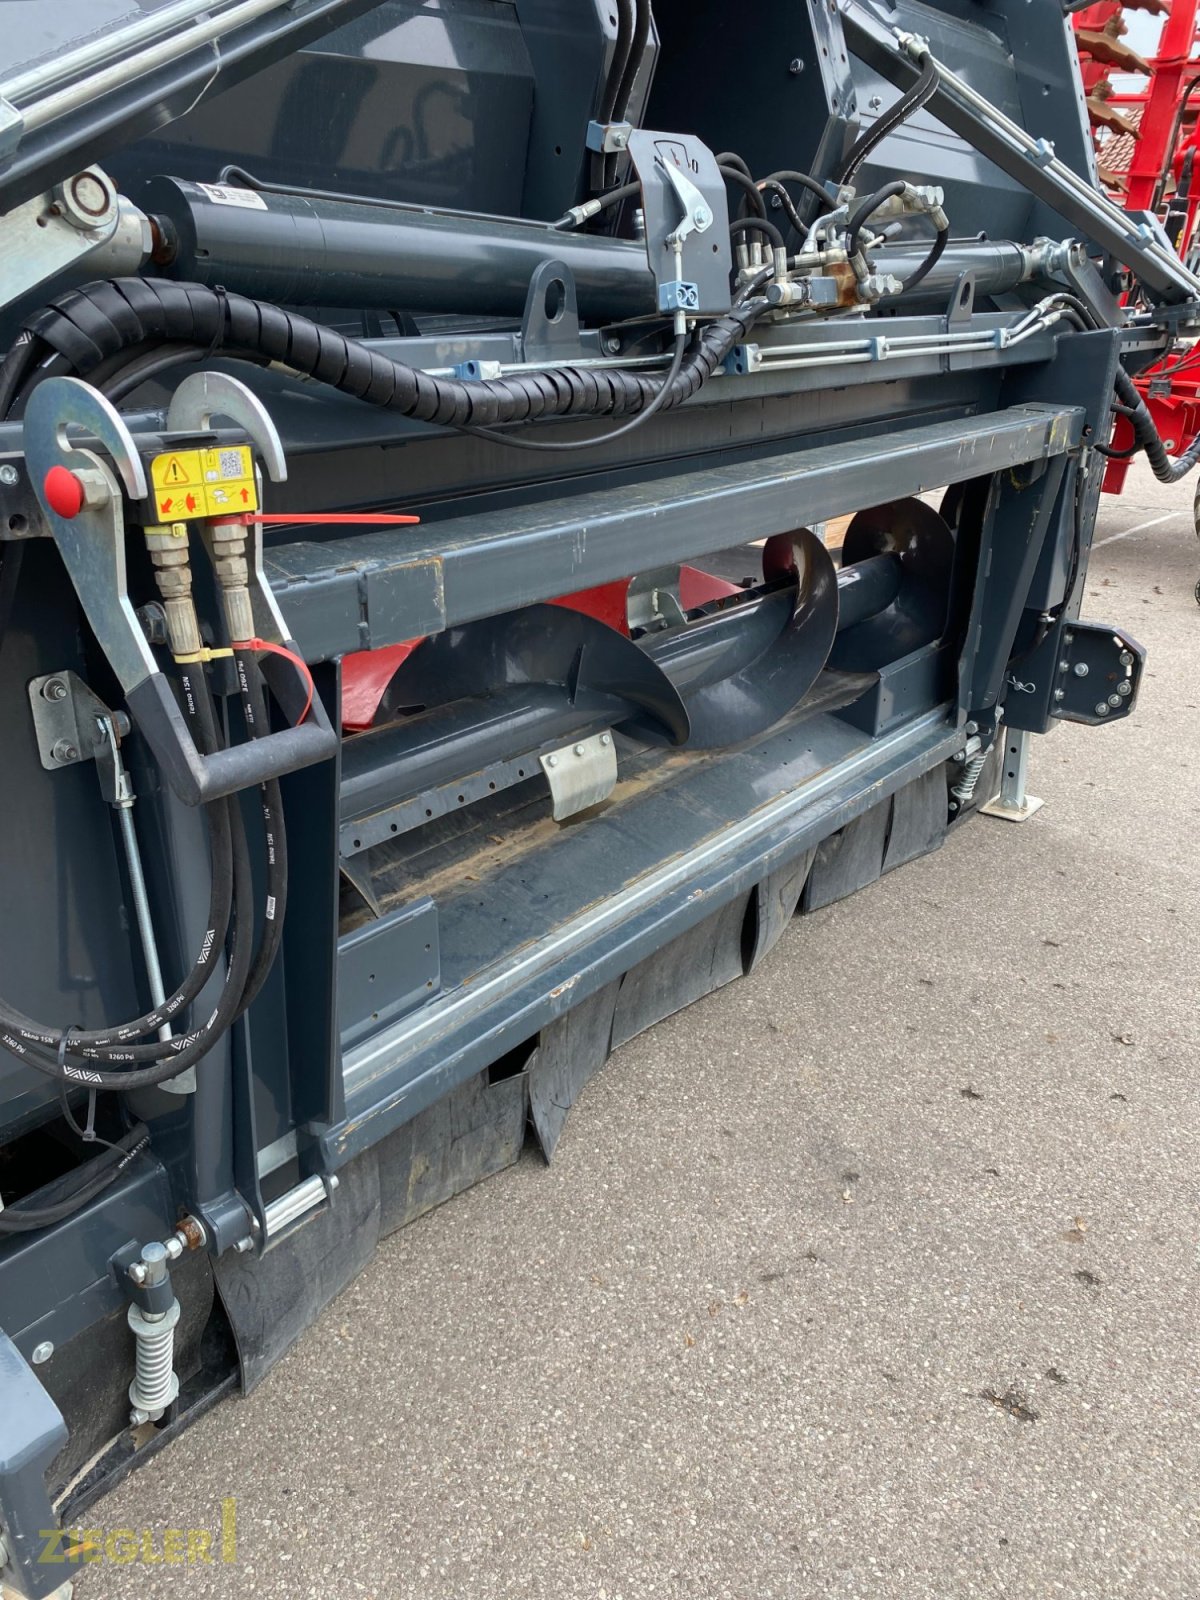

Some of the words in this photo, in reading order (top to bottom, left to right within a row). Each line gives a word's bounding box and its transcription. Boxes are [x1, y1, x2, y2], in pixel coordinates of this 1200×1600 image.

[240, 673, 249, 693] 3260
[186, 693, 196, 715] Tekno
[166, 1000, 180, 1014] 3260
[2, 1034, 17, 1048] 3260
[15, 1043, 27, 1054] Psi
[20, 1030, 40, 1041] Tekno
[108, 1053, 125, 1061] 3260
